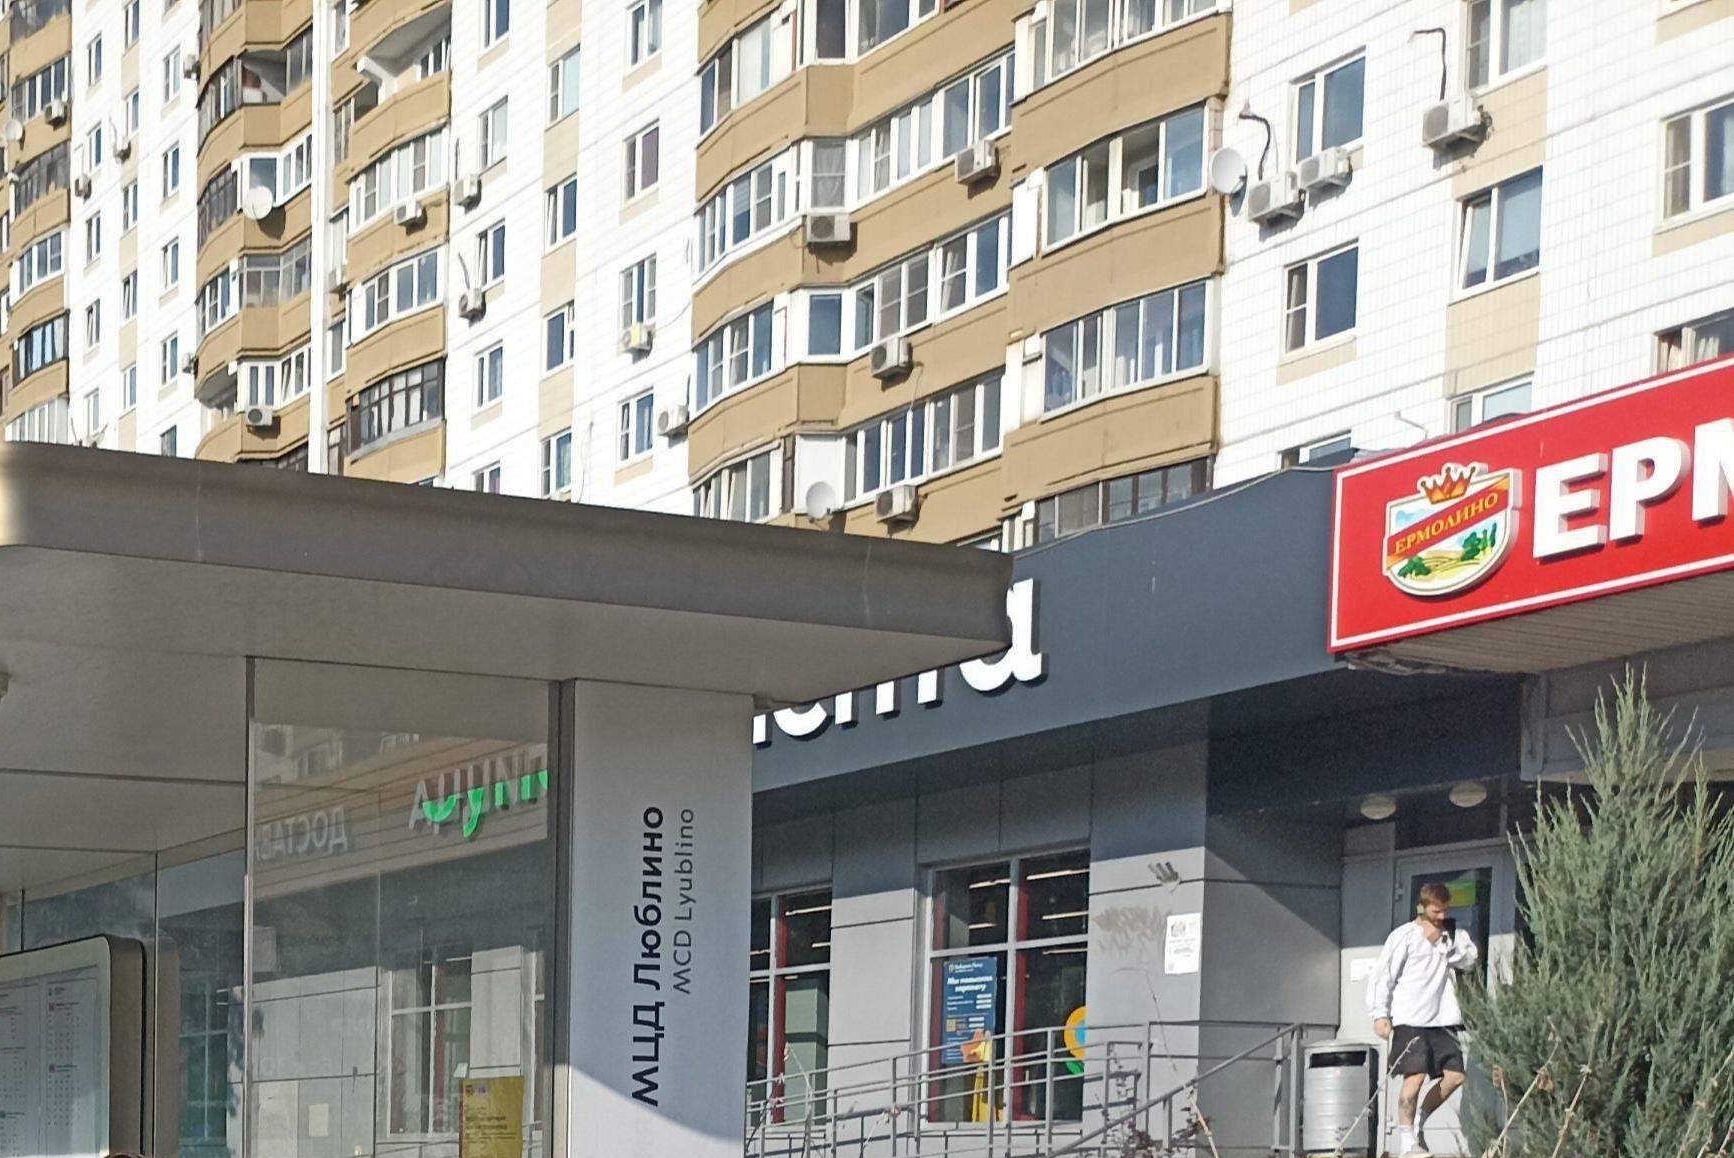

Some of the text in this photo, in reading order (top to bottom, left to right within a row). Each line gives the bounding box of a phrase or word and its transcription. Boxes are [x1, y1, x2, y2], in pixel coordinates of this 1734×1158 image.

[1394, 492, 1499, 556] ЕРМОЛИНО
[631, 806, 665, 1107] МЦД Люблино
[673, 808, 696, 994] MCD Lyublino
